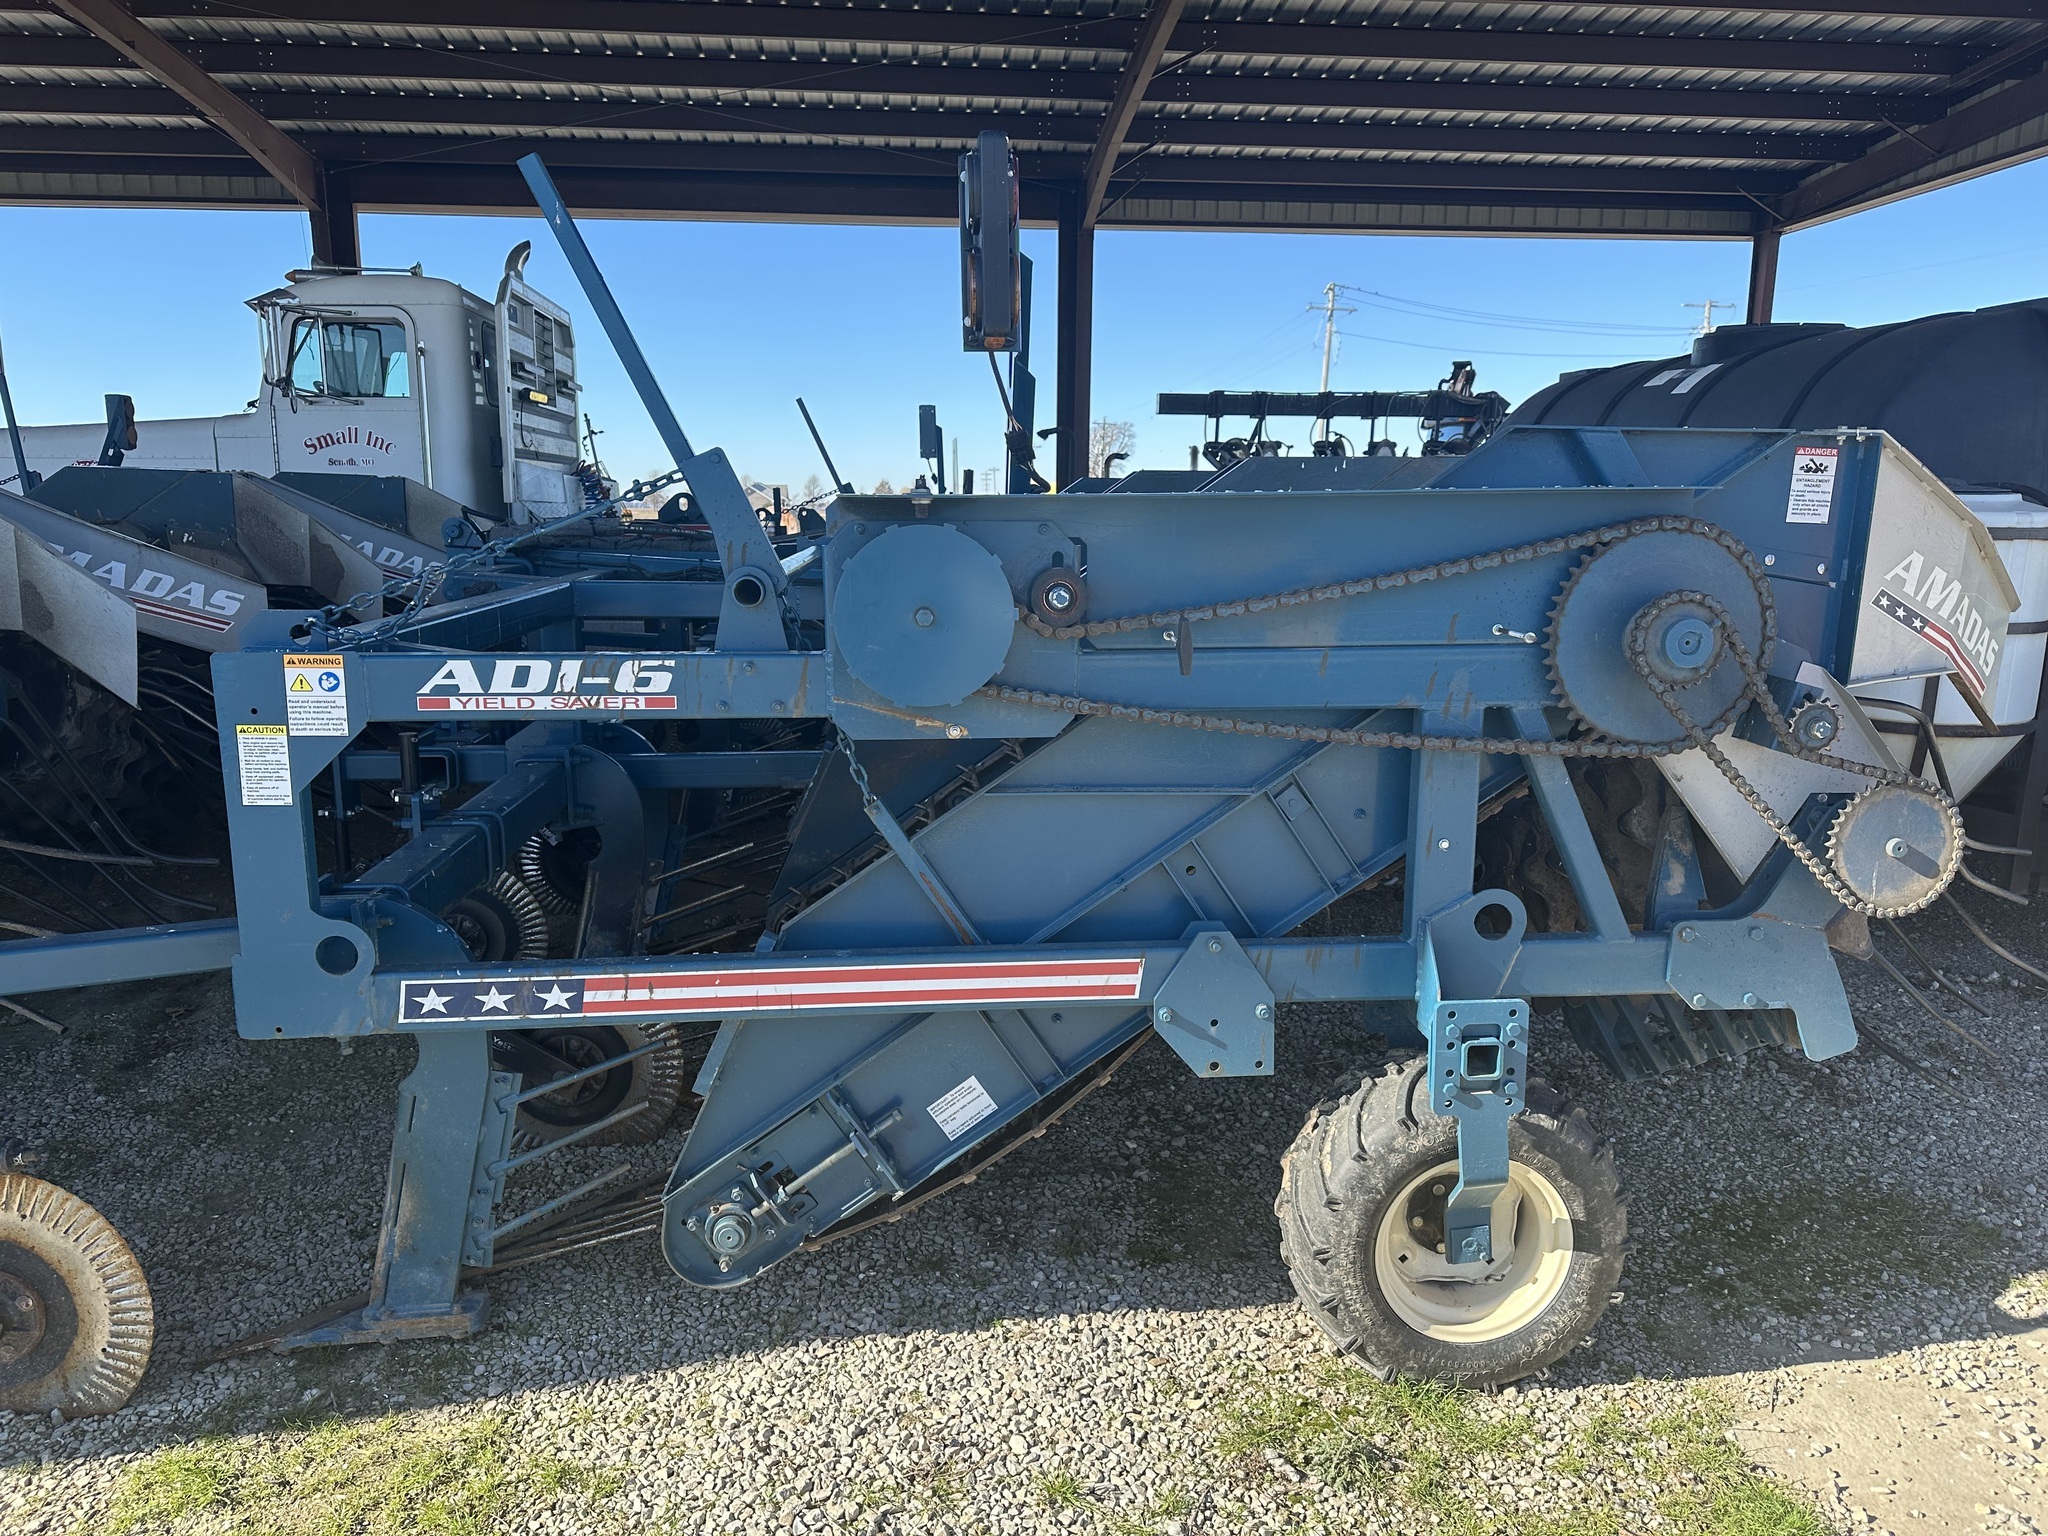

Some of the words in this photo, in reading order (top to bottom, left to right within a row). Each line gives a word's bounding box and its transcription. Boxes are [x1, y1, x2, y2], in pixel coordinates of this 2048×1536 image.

[303, 426, 359, 455] Small
[365, 430, 396, 455] Inc
[47, 542, 245, 616] ADAS
[1884, 550, 1998, 677] AMADAS
[416, 660, 675, 694] ADI-6
[456, 697, 535, 709] YIELD
[550, 697, 640, 709] SAVER
